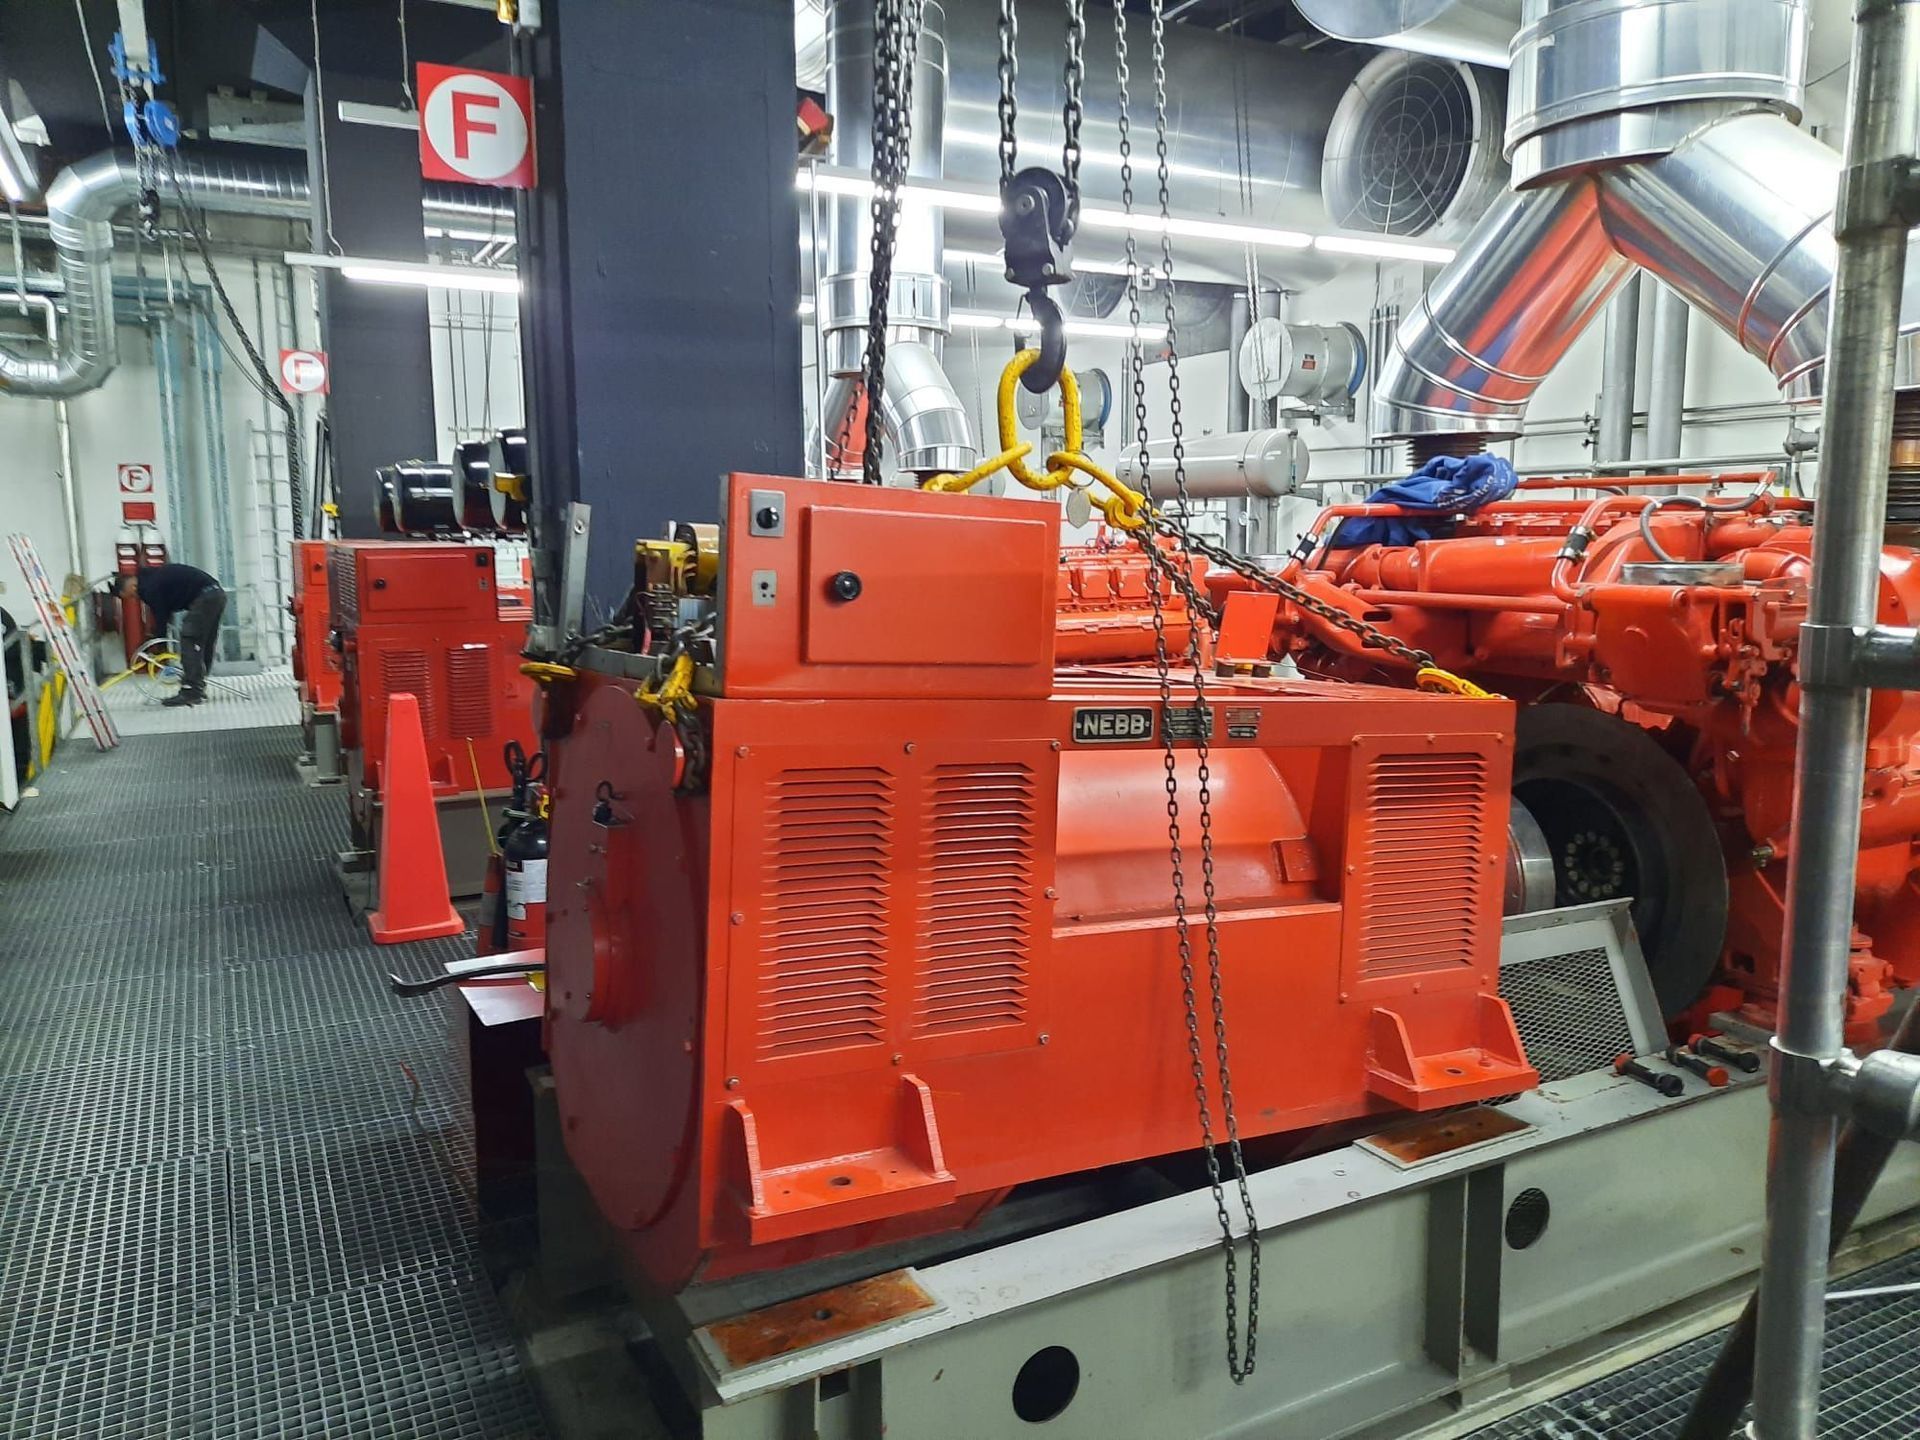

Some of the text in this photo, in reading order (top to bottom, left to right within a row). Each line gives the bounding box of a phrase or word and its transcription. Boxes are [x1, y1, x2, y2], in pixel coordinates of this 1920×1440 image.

[452, 91, 499, 160] F
[294, 360, 313, 384] F
[128, 469, 143, 487] F
[1083, 713, 1145, 736] NEBB
